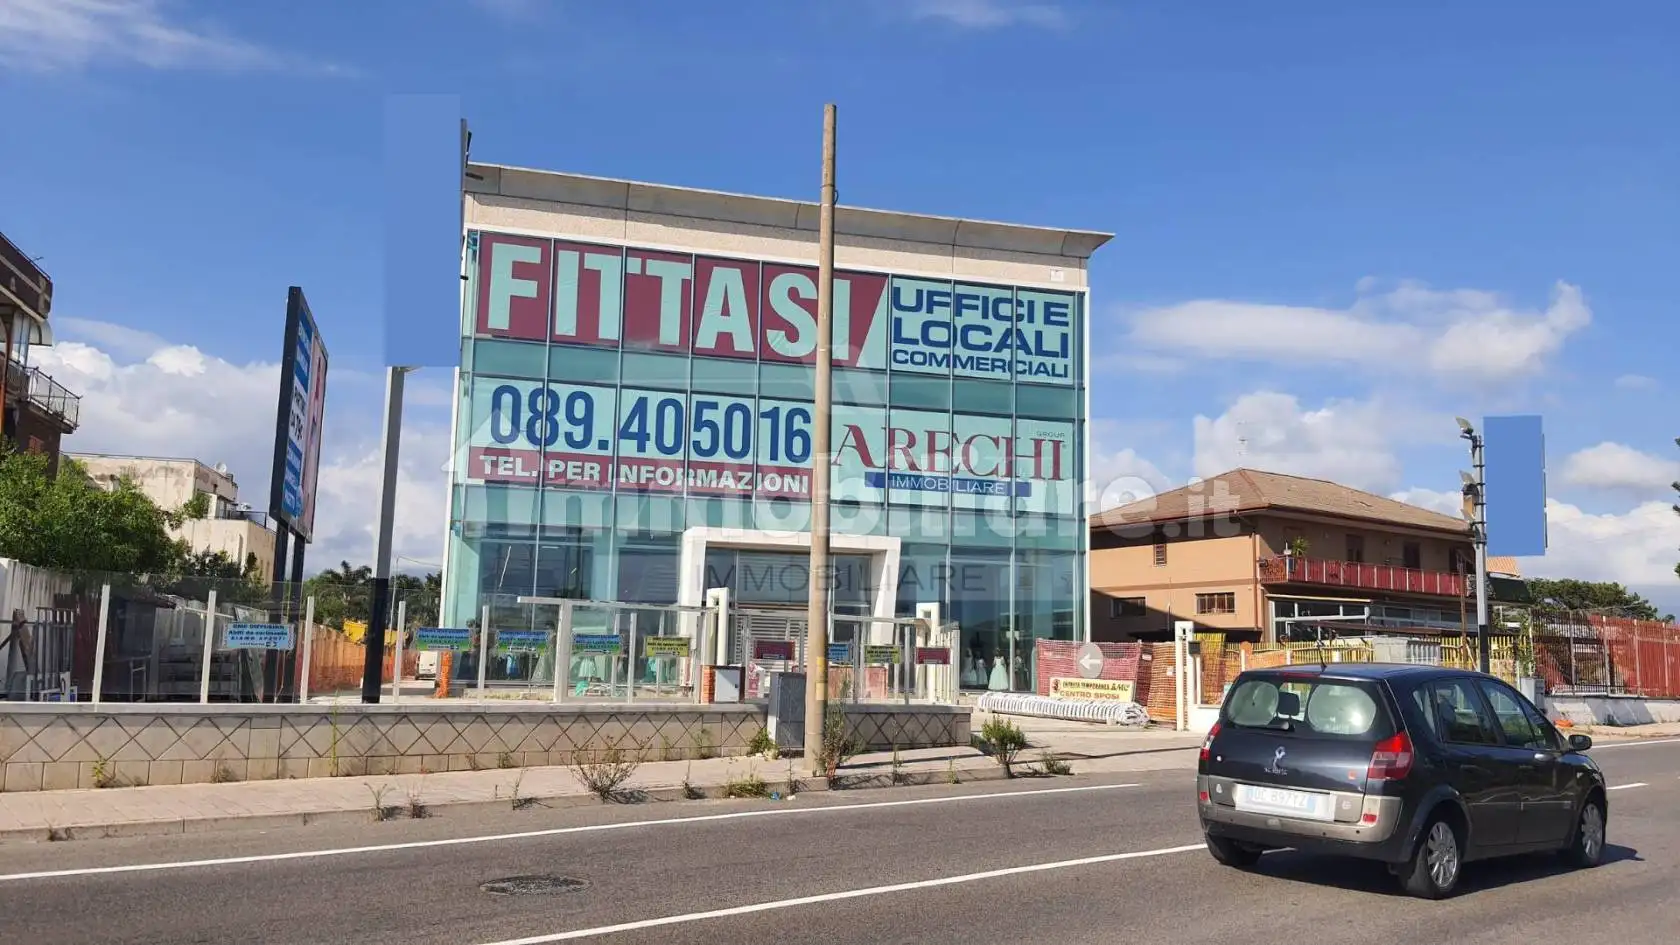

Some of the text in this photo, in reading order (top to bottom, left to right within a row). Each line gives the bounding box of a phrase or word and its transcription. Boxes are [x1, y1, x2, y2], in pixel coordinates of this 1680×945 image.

[488, 243, 851, 361] FITTASI
[893, 287, 1069, 327] UFFICI E
[893, 317, 1068, 358] LOCALI
[893, 349, 1068, 378] COMMERCIALI
[491, 385, 811, 463] 089.405016
[833, 424, 1065, 481] ARECHI
[480, 455, 808, 494] TEL. PER INFORMAZIONI
[891, 475, 1006, 495] IMMOBILIARE
[1060, 690, 1092, 698] CENTRO
